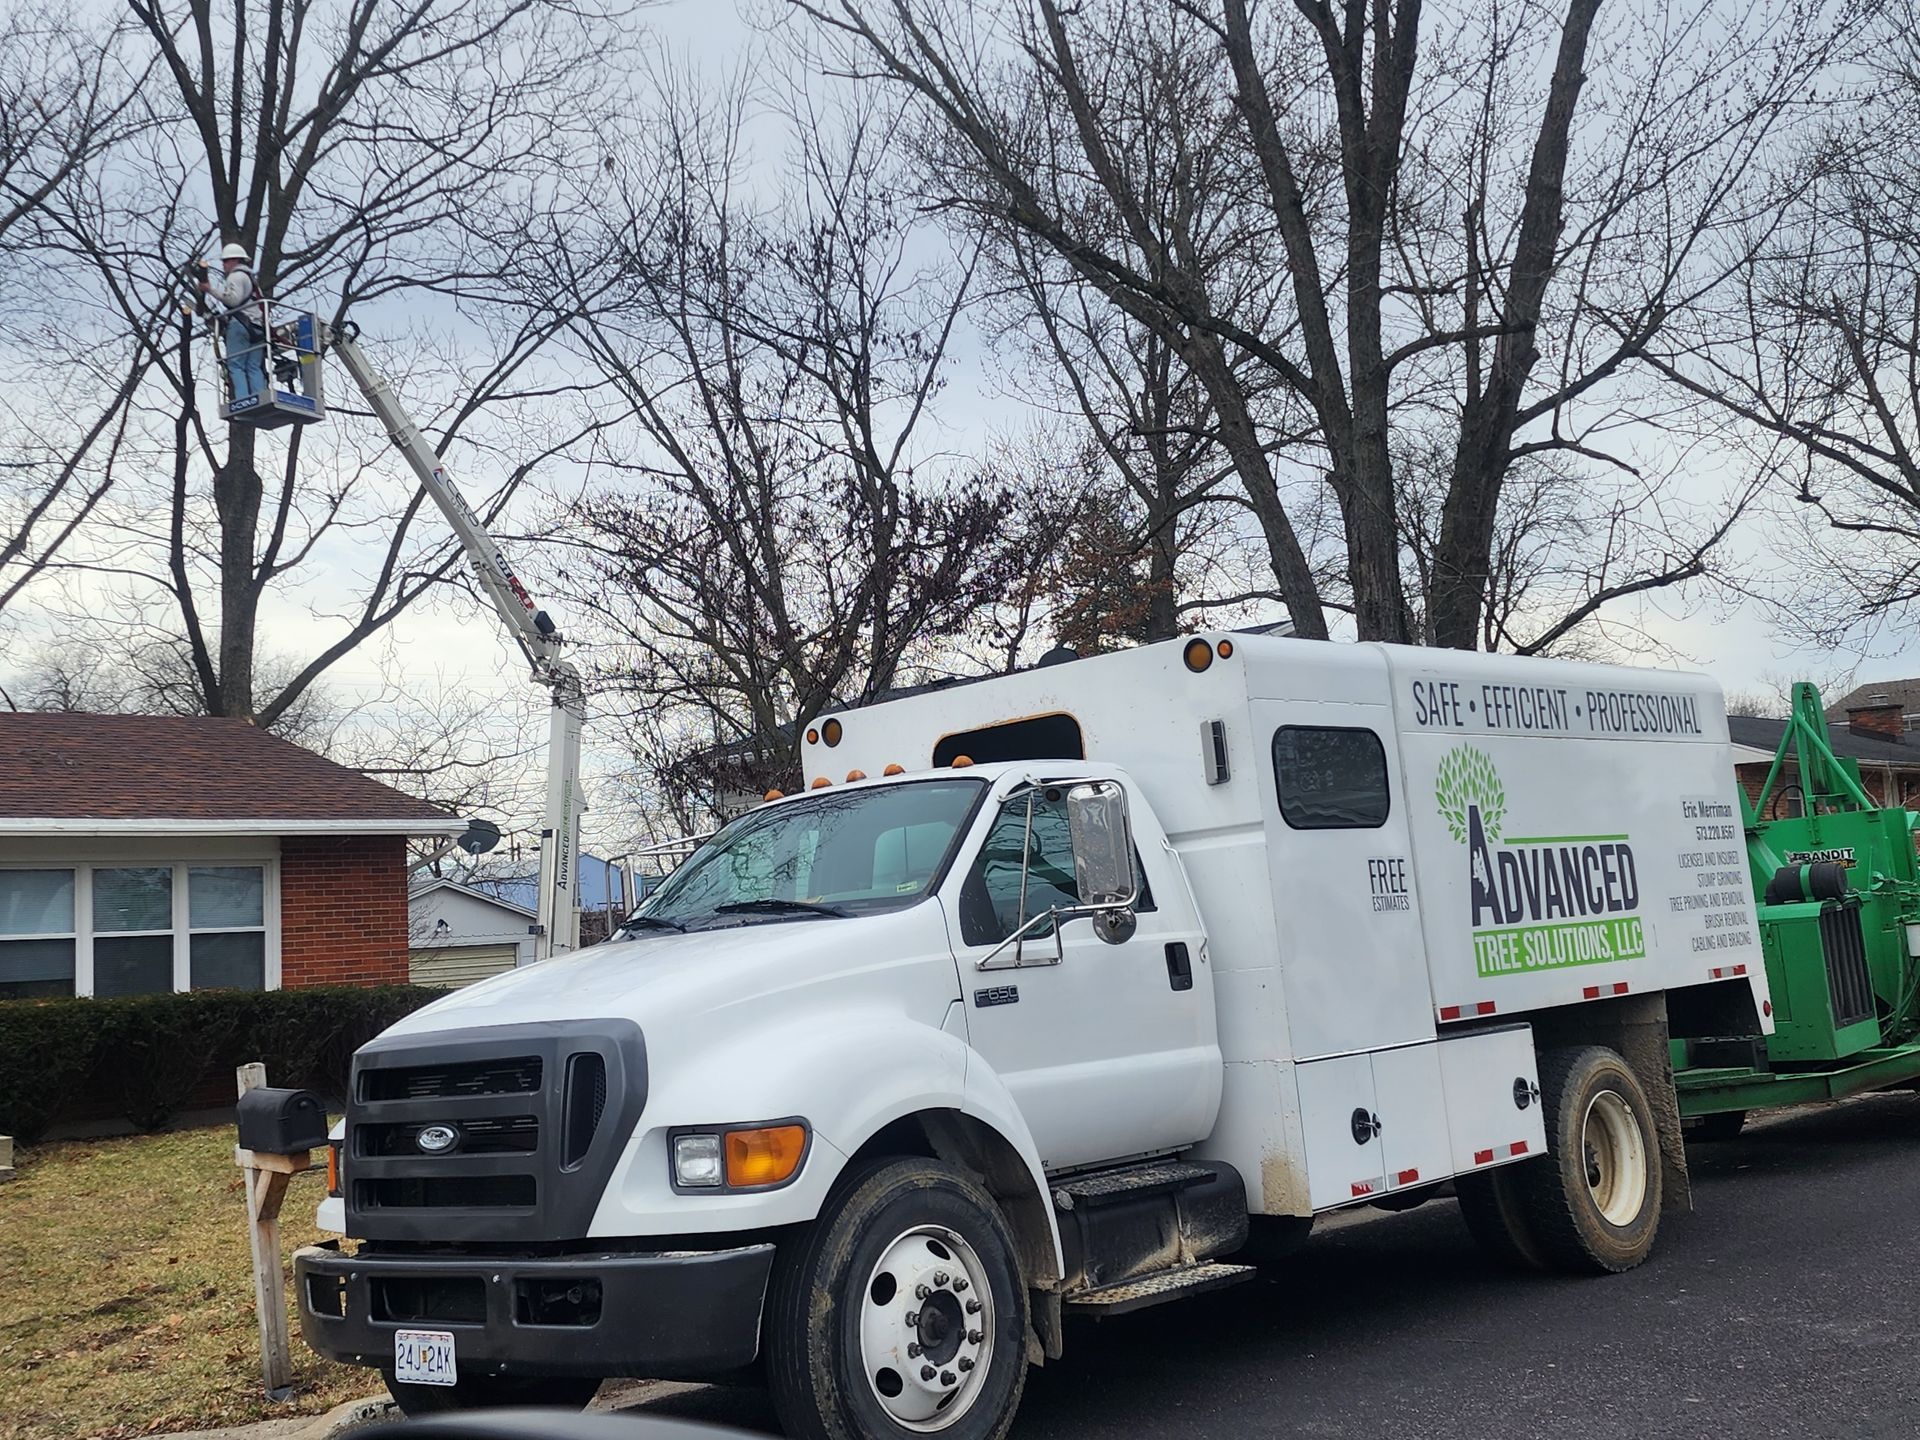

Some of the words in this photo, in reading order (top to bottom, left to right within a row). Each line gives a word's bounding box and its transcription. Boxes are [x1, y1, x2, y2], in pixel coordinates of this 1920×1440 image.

[1412, 680, 1464, 726] SAFE
[1482, 685, 1569, 730] EFFICIENT
[1586, 691, 1702, 734] PROFESSIONAL
[1682, 800, 1698, 819] Eric
[557, 836, 570, 890] ADVANCED
[1468, 805, 1639, 927] ADVANCED
[1678, 852, 1704, 869] LICENSED
[1704, 851, 1717, 866] AND
[1717, 850, 1740, 865] INSURED
[1805, 849, 1853, 864] BANDIT
[1368, 858, 1408, 894] FREE
[1697, 872, 1716, 888] STUMP
[1716, 870, 1743, 887] GRINDING
[1372, 895, 1410, 912] ESTIMATES
[1669, 895, 1684, 913] TREE
[1684, 893, 1709, 910] PRUNING
[1709, 892, 1721, 908] AND
[1721, 890, 1746, 907] REMOVAL
[1704, 913, 1725, 929] BRUSH
[1724, 911, 1749, 927] REMOVAL
[1474, 932, 1522, 973] TREE
[1523, 924, 1616, 968] SOLUTIONS,
[1614, 920, 1644, 956] LLC
[1692, 935, 1717, 952] CABLING
[1716, 934, 1728, 949] AND
[1728, 931, 1752, 947] BRACING
[398, 1343, 421, 1371] 24J
[427, 1345, 452, 1374] 2AK
